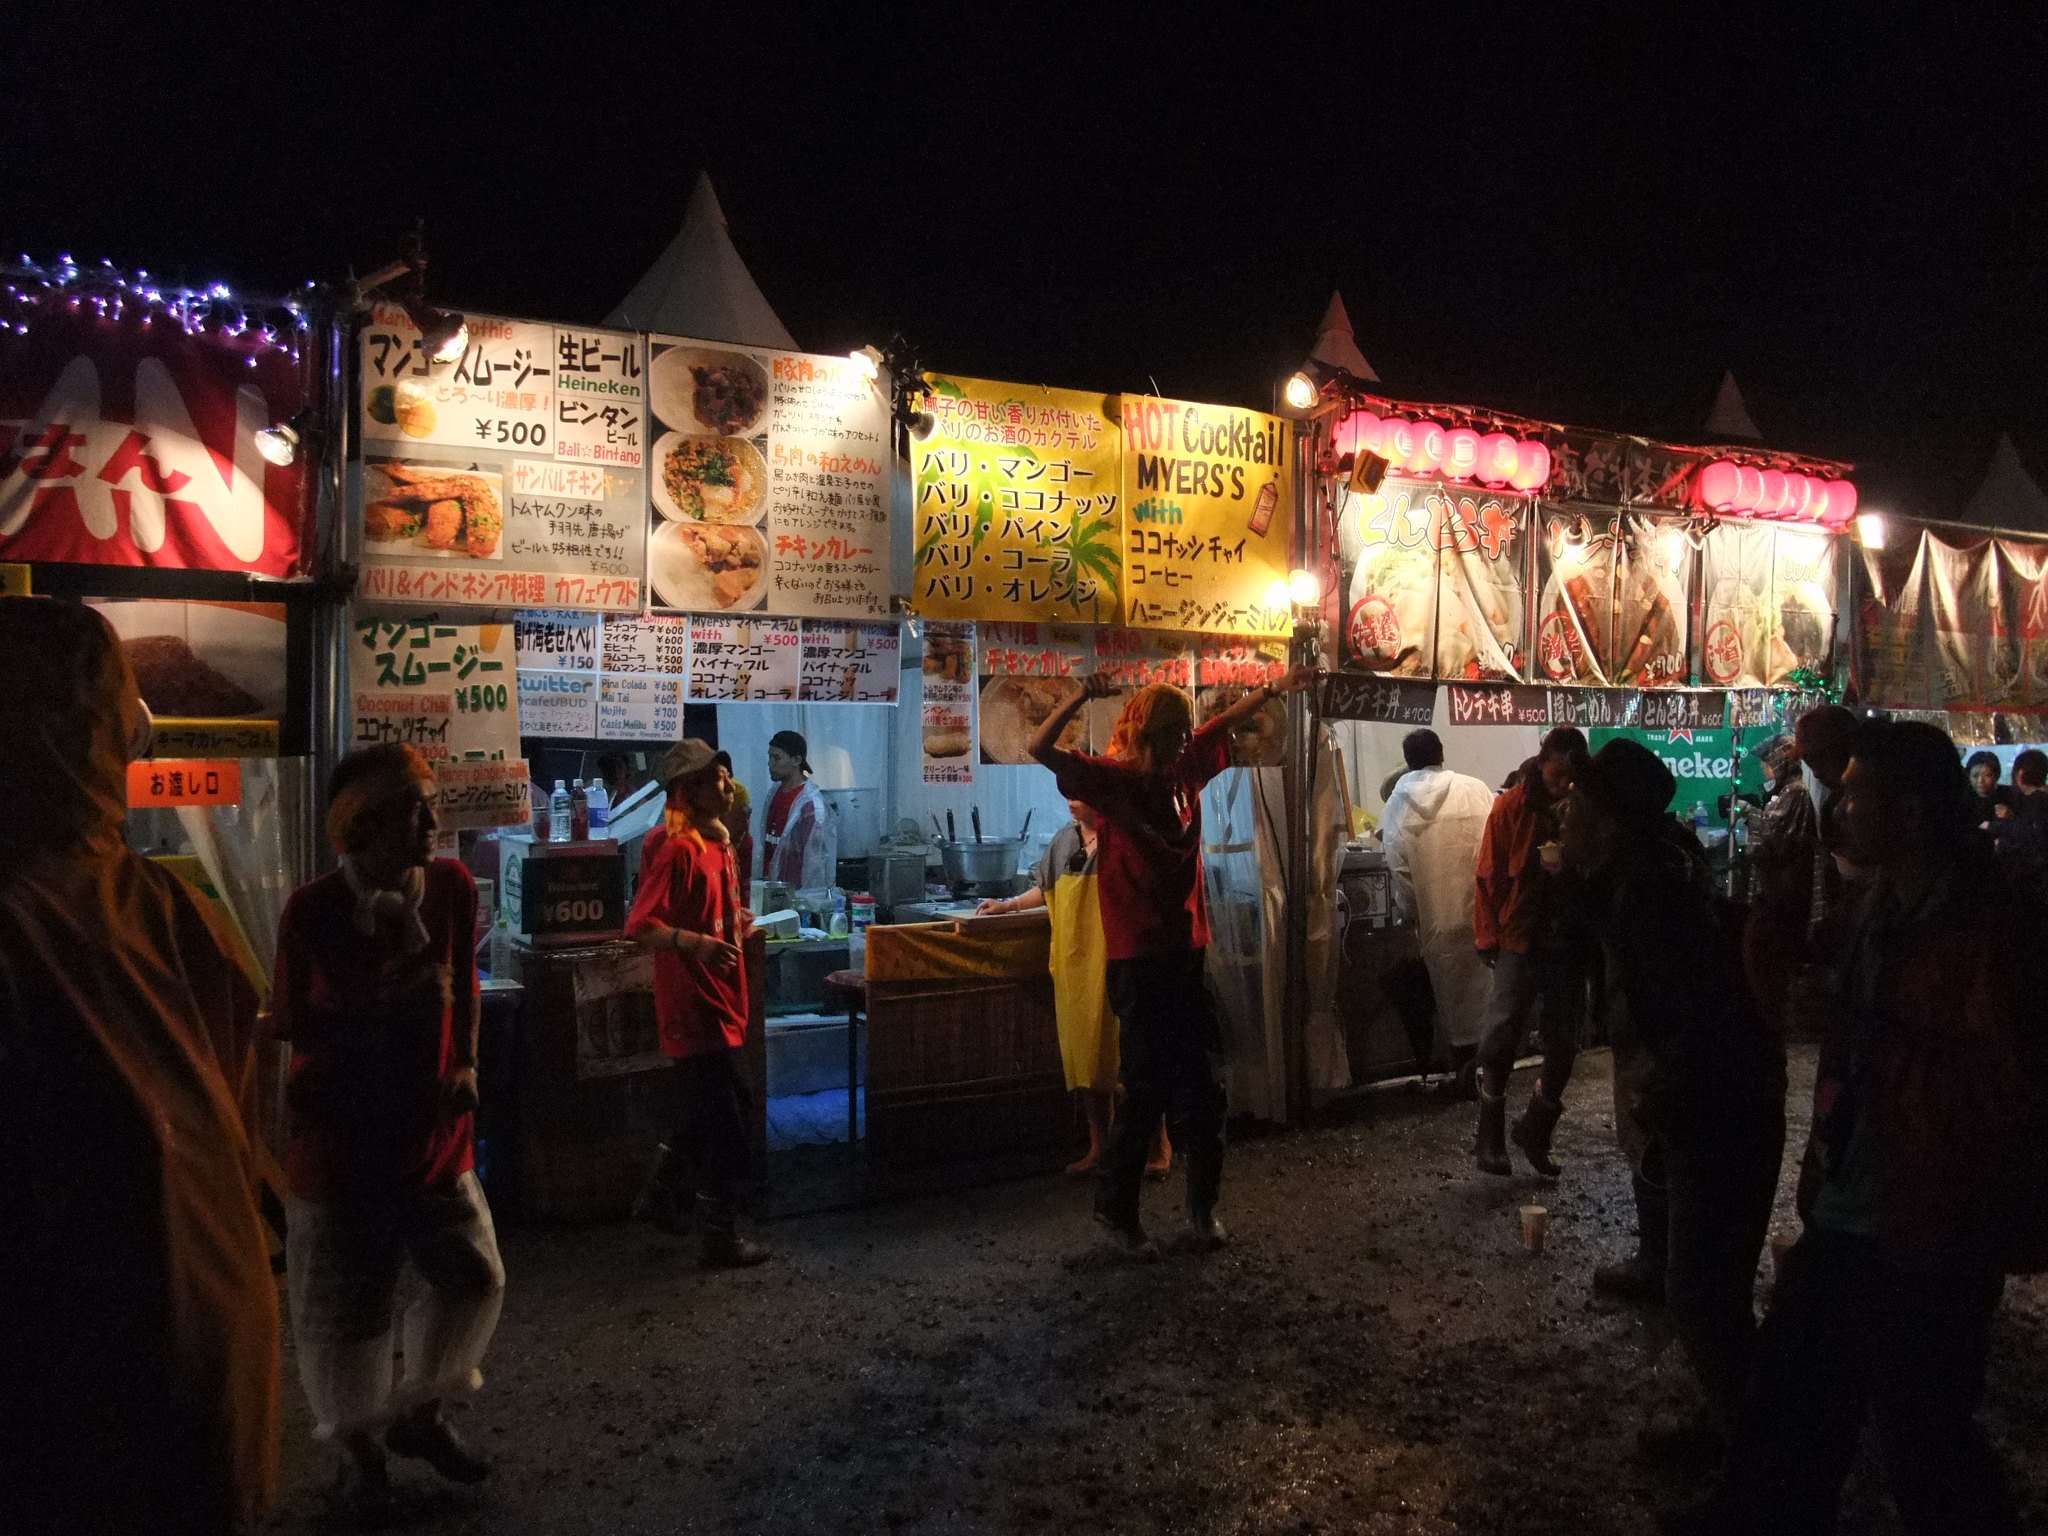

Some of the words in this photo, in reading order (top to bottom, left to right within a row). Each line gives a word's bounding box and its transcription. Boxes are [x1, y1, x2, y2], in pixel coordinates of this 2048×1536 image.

[370, 335, 551, 389] マンゴスムージー
[559, 333, 641, 378] 生ビール
[560, 401, 638, 430] ビンタン
[475, 418, 546, 447] ¥500
[607, 430, 638, 446] ビール
[1123, 402, 1180, 452] HOT
[1182, 407, 1285, 467] Cocktail
[922, 450, 1095, 484] バリ・マンゴー
[516, 465, 603, 496] サンバルチキン
[922, 484, 1118, 516] バリ・ココナッツ
[1133, 498, 1183, 525] with
[923, 514, 1073, 543] バリ・パイン
[775, 534, 873, 560] チキンカレー
[924, 546, 1073, 573] バリ・コーラ
[591, 562, 629, 576] ¥500
[1132, 565, 1193, 588] コーヒー
[364, 569, 545, 604] バリ&インドネシア料理
[555, 577, 639, 606] カフェウブド
[925, 577, 1097, 604] バリ・オレンジ
[355, 612, 457, 650] マンゴー
[604, 633, 638, 643] マイタイ
[656, 635, 683, 645] ¥600
[657, 626, 684, 635] ¥600
[691, 629, 721, 640] with
[764, 635, 798, 646] ¥500
[801, 634, 830, 645] with
[867, 638, 899, 650] ¥500
[603, 643, 636, 653] モヒート
[656, 645, 683, 654] ¥700
[603, 653, 645, 662] ラムコーラ
[656, 655, 682, 664] ¥500
[693, 642, 775, 655] 濃厚マンゴー
[803, 646, 878, 659] 濃厚マンゴー
[985, 646, 1085, 676] チキンカレー
[376, 644, 503, 687] スムージー
[558, 655, 594, 670] ¥150
[603, 663, 655, 673] ラムマンゴー
[656, 665, 683, 674] ¥500
[654, 681, 678, 691] ¥600
[691, 673, 752, 685] ココナッツ
[456, 684, 508, 713] ¥500
[654, 694, 677, 705] ¥600
[754, 689, 792, 700] コーラ
[1330, 681, 1402, 719] トンテキ丼
[1402, 707, 1431, 721] ¥700
[1453, 687, 1514, 722] トンテキ串
[1518, 708, 1546, 723] ¥500
[653, 720, 677, 731] ¥500
[654, 707, 678, 718] ¥700
[357, 716, 450, 743] ココナッツチャイ
[151, 771, 220, 796] お渡し口
